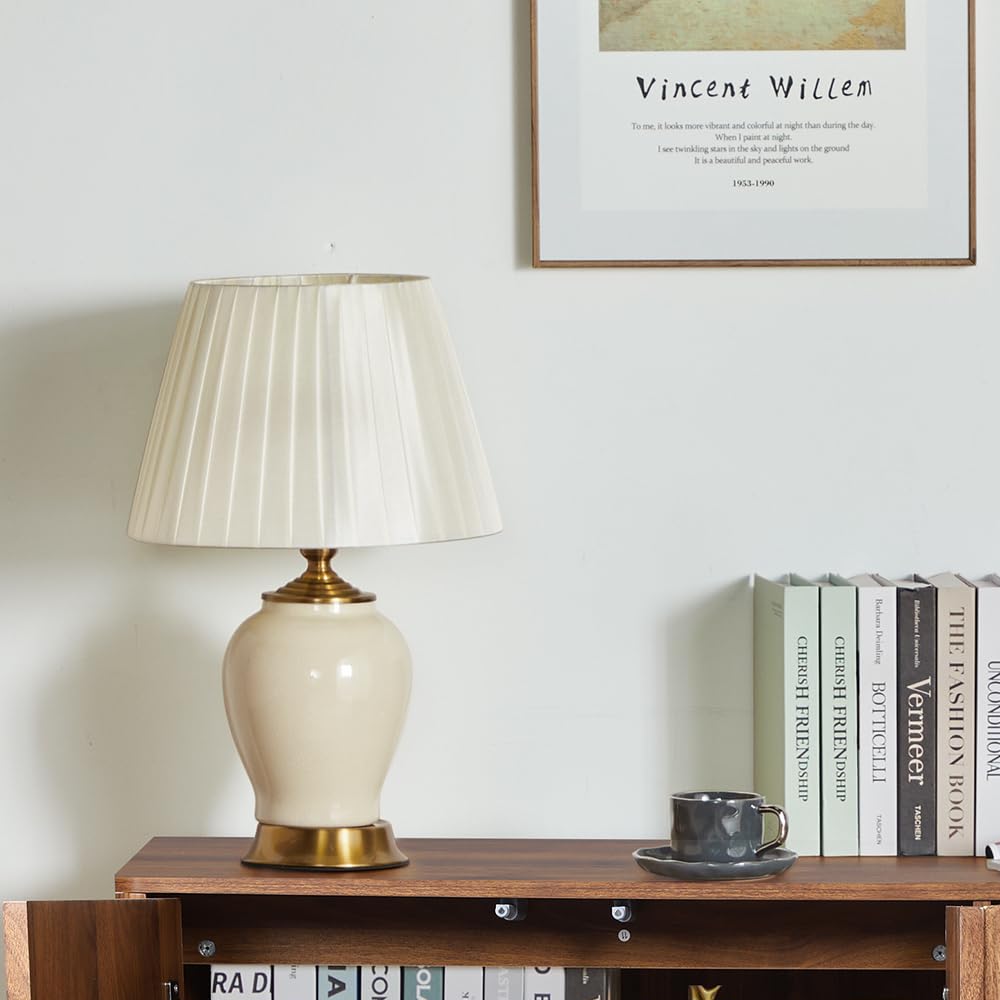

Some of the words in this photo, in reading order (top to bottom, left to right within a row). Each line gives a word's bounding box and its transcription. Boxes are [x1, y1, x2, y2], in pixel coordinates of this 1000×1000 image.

[636, 76, 750, 100] Vincent
[769, 74, 872, 100] Willem
[665, 122, 683, 130] looks
[732, 121, 745, 129] and
[747, 121, 774, 129] colorful
[785, 121, 802, 131] night
[823, 121, 846, 130] during
[861, 121, 875, 130] day.
[715, 133, 736, 141] When
[744, 134, 761, 143] paint
[772, 132, 792, 143] night.
[676, 145, 709, 154] twinkling
[750, 144, 761, 154] sky
[764, 144, 777, 152] and
[779, 144, 798, 154] lights
[811, 144, 822, 152] the
[824, 144, 850, 154] ground
[695, 156, 699, 164] It
[715, 156, 745, 164] beautiful
[748, 156, 760, 164] and
[763, 155, 792, 165] peaceful
[794, 155, 813, 163] work.
[733, 179, 774, 187] 1953-1990
[875, 598, 883, 628] Barbara
[949, 607, 965, 655] THE
[796, 636, 809, 699] CHERISH
[834, 636, 846, 699] CHERISH
[874, 631, 883, 665] Deimling
[872, 682, 886, 783] BOTTICELLI
[906, 676, 931, 786] Vermeer
[949, 663, 965, 766] FASHION
[795, 706, 809, 802] FRIENDSHIP
[833, 706, 847, 802] FRIENDSHIP
[948, 775, 964, 839] BOOK
[212, 972, 244, 993] RA
